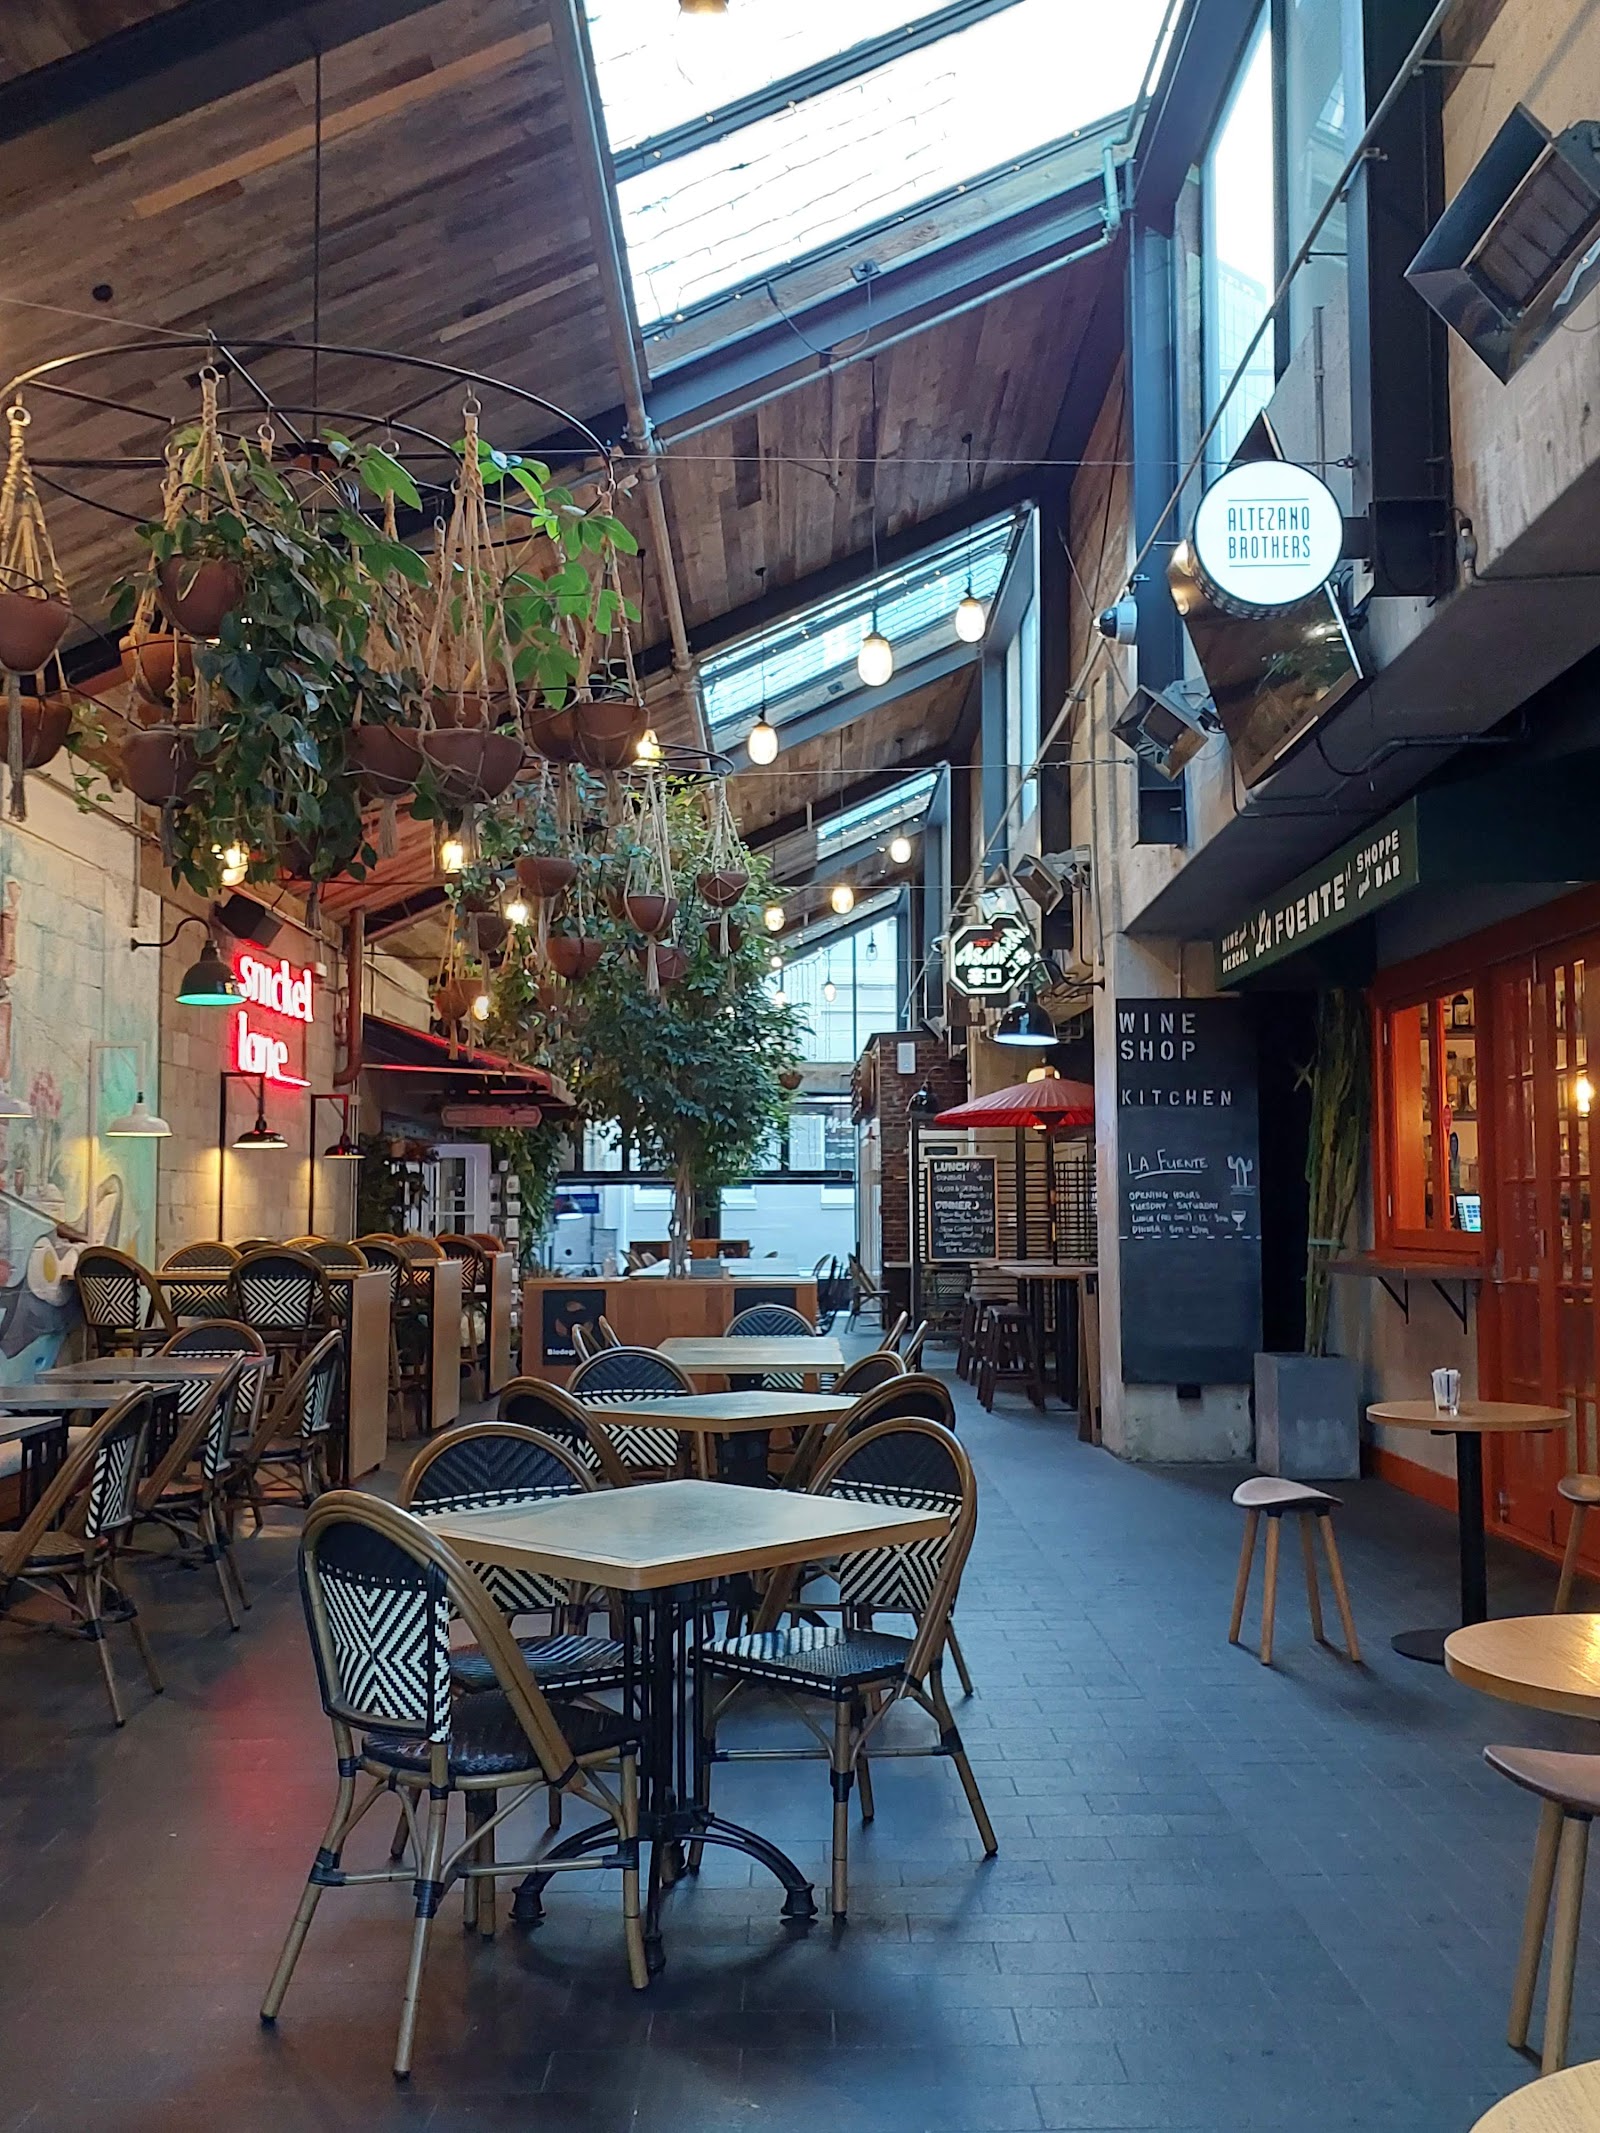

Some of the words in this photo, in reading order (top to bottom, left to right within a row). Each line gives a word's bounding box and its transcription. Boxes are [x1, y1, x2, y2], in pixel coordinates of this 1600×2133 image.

[1228, 506, 1310, 531] ALTEZANO
[1228, 535, 1311, 559] BROTHERS
[1356, 829, 1400, 873] SHOPPE
[1375, 855, 1400, 888] BAR
[1274, 872, 1346, 946] FUENTE
[955, 940, 1007, 966] Asah
[1222, 946, 1249, 974] MEZCAL
[1118, 1012, 1196, 1034] WINE
[1120, 1040, 1196, 1061] SHOP
[1121, 1089, 1232, 1106] KITCHEN
[933, 1161, 970, 1173] LUNCH
[1127, 1152, 1149, 1174] LA
[1157, 1149, 1209, 1171] FUENTE
[934, 1200, 972, 1210] DINNER
[1129, 1190, 1168, 1200] OPENING
[1173, 1190, 1201, 1200] HOURS
[1130, 1202, 1166, 1211] TUESDAY
[1176, 1201, 1219, 1210] SATURDAY
